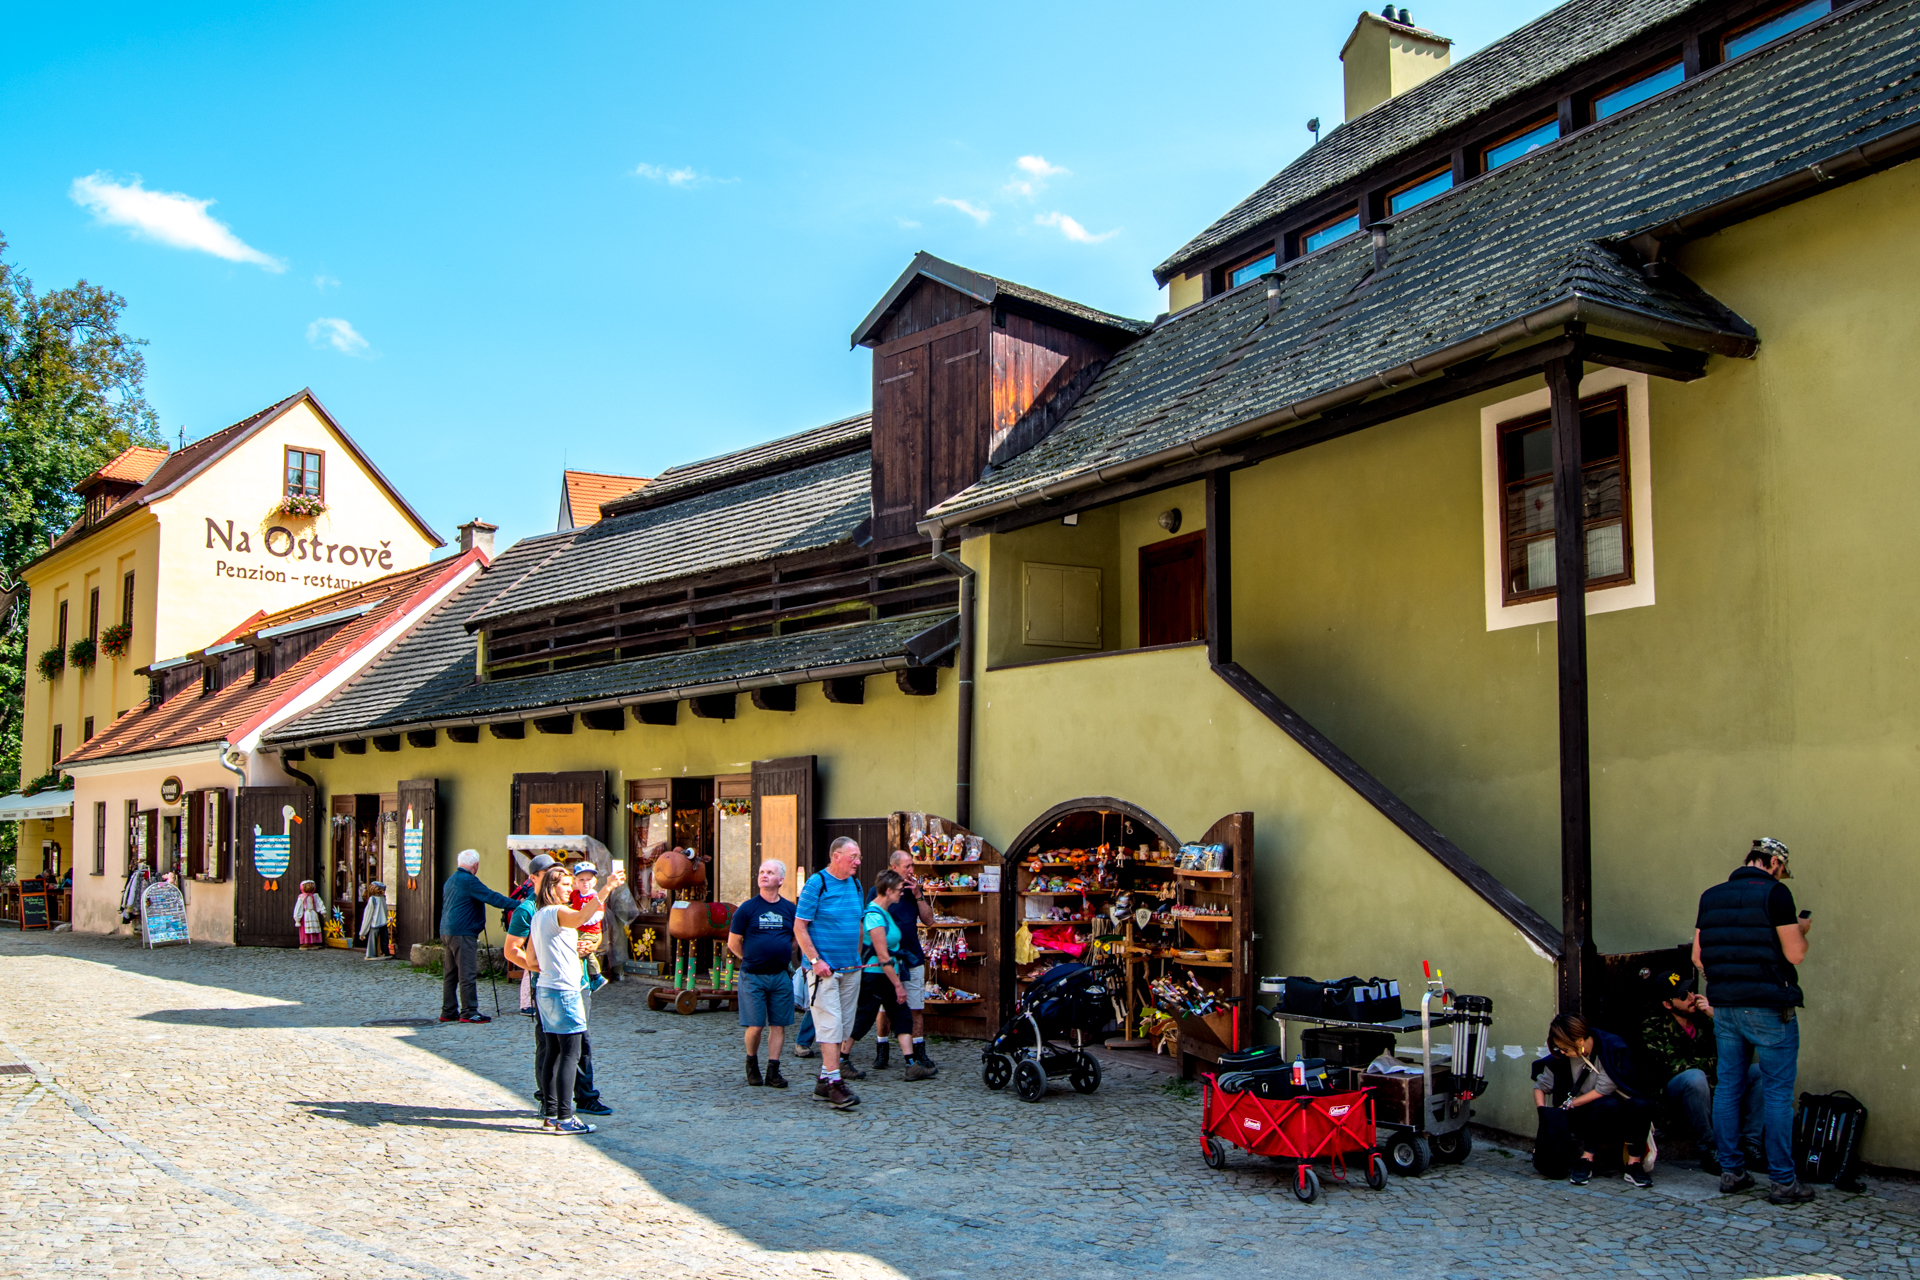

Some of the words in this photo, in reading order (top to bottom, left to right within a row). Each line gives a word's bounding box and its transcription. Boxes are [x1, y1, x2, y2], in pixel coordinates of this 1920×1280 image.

[205, 517, 251, 554] Na
[264, 525, 394, 570] Ostrově
[216, 560, 286, 583] Penzion
[980, 876, 999, 884] KASA
